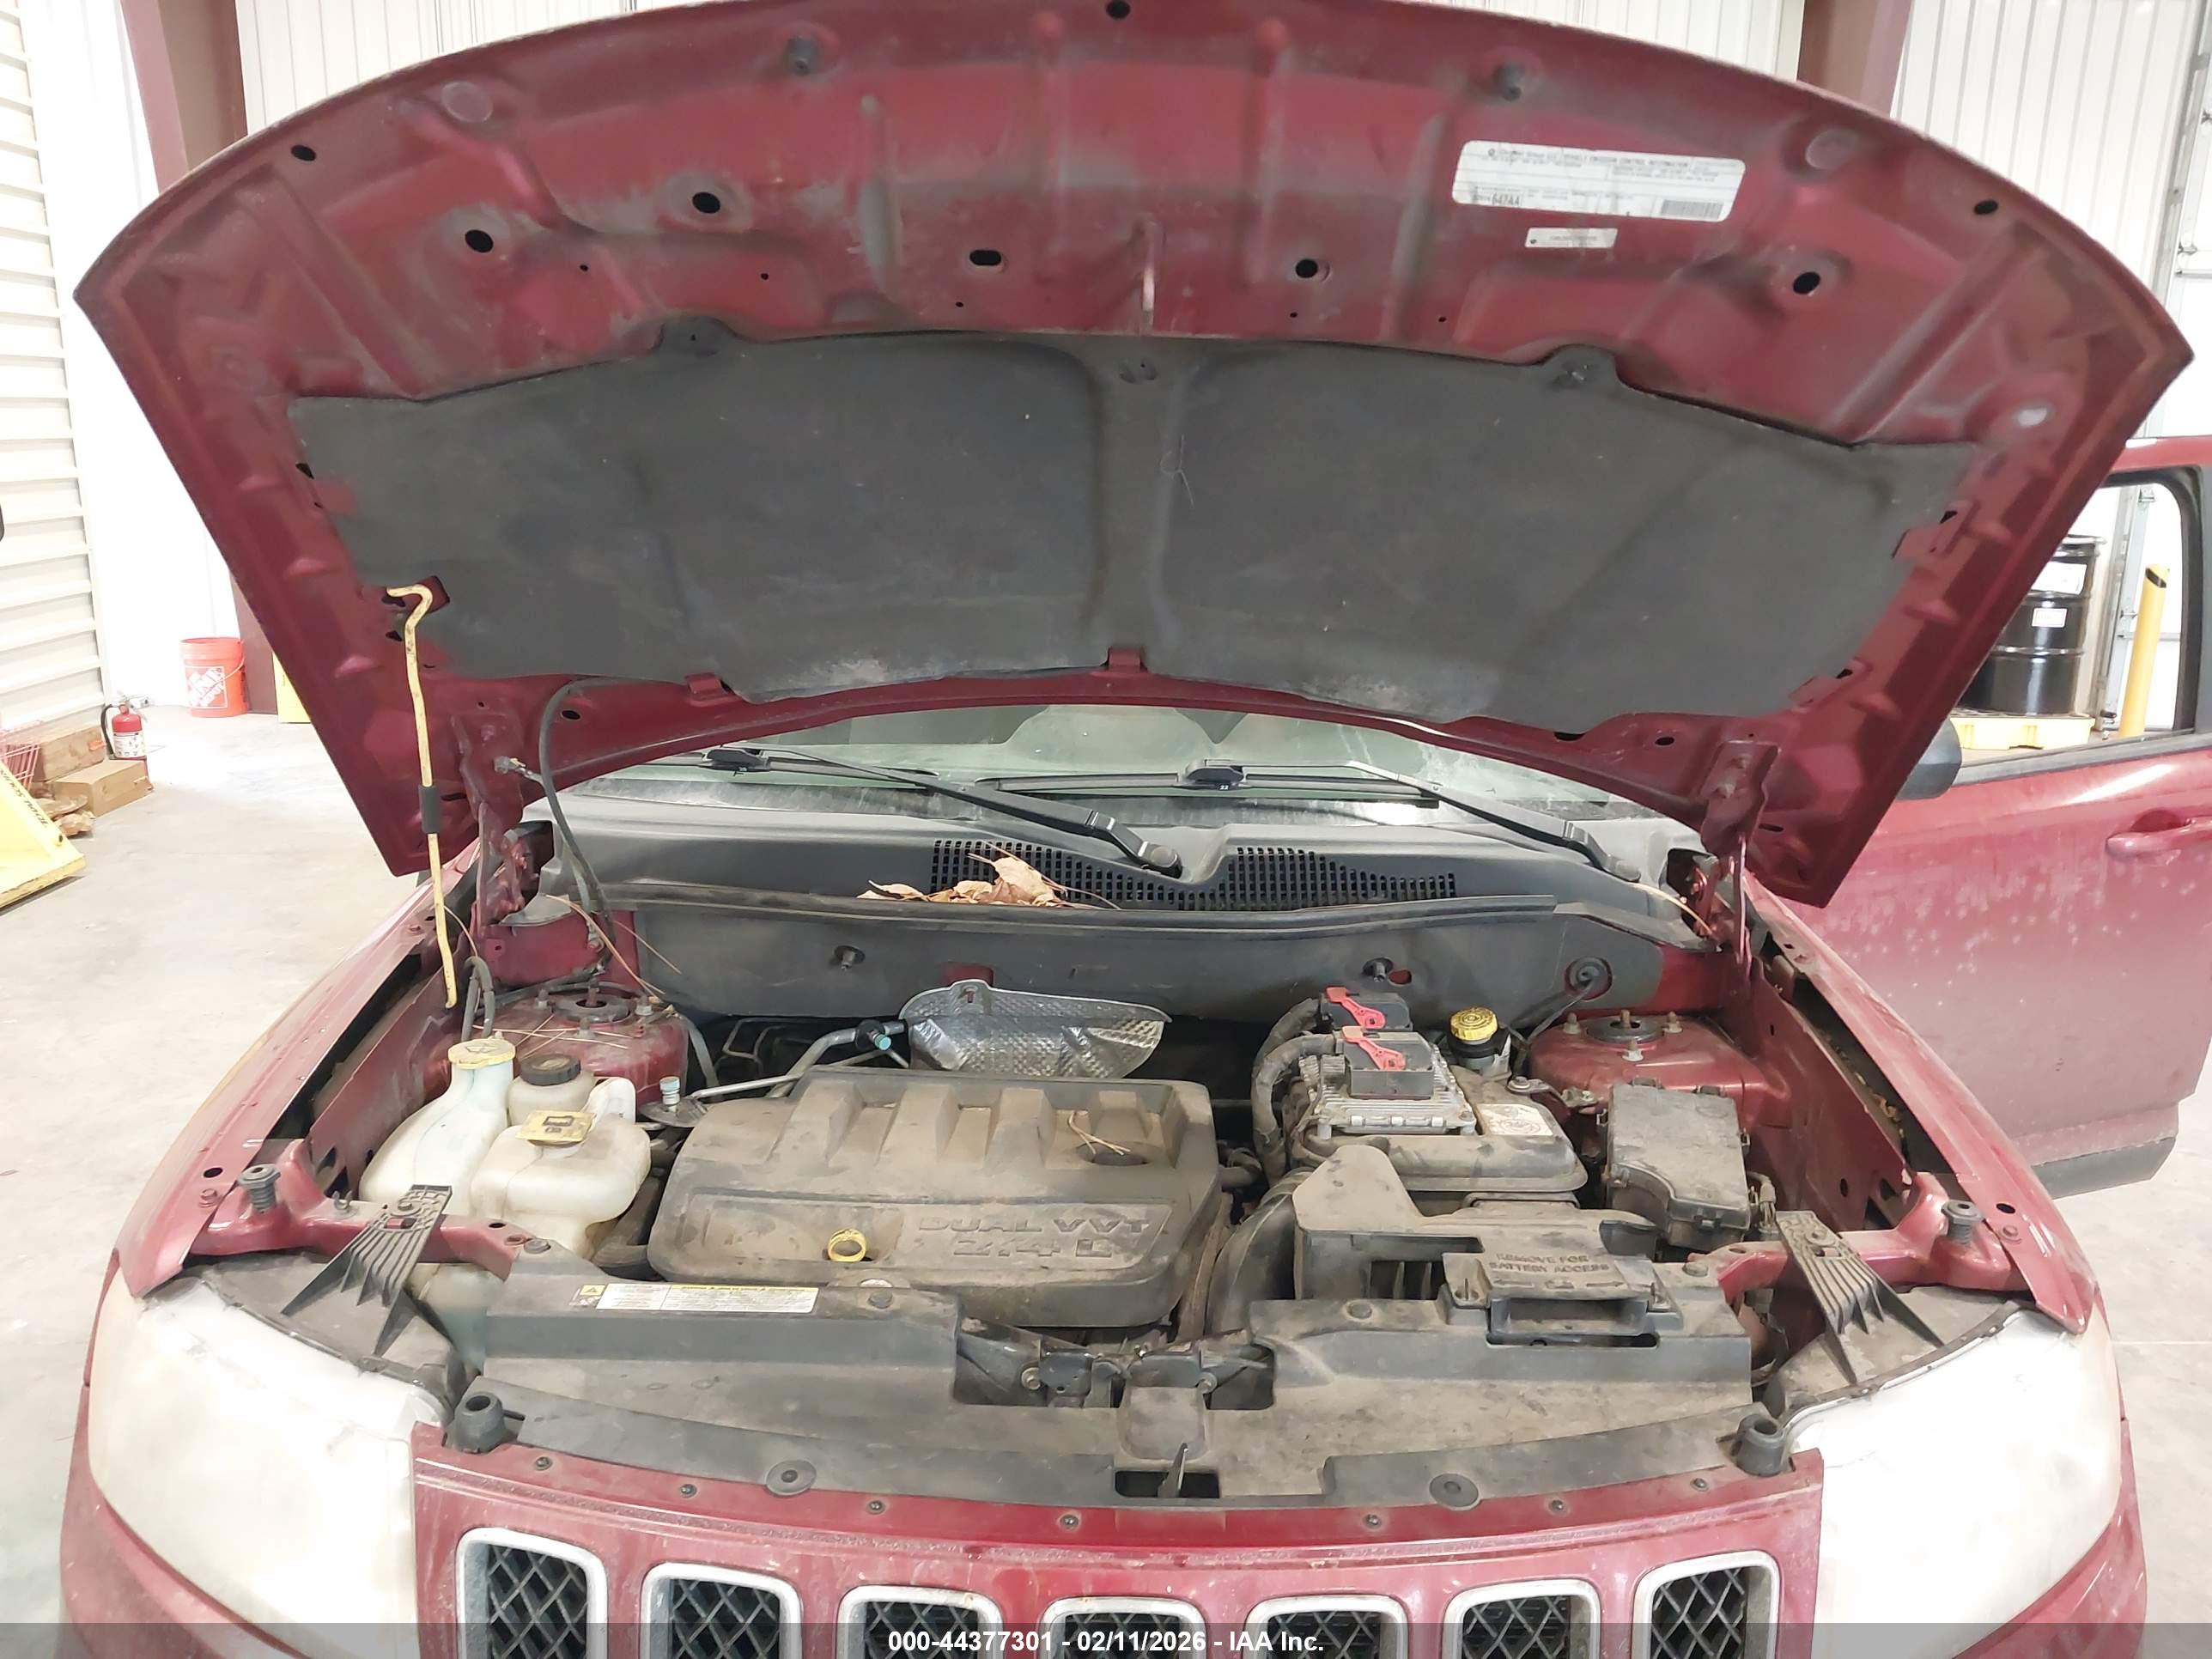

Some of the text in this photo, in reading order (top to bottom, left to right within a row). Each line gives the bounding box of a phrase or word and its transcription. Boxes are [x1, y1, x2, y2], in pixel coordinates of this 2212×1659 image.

[919, 1218, 1149, 1234] DUAL VVT
[1496, 1253, 1589, 1264] REMOVE FOR
[1489, 1261, 1610, 1273] BATTERY ACCESS
